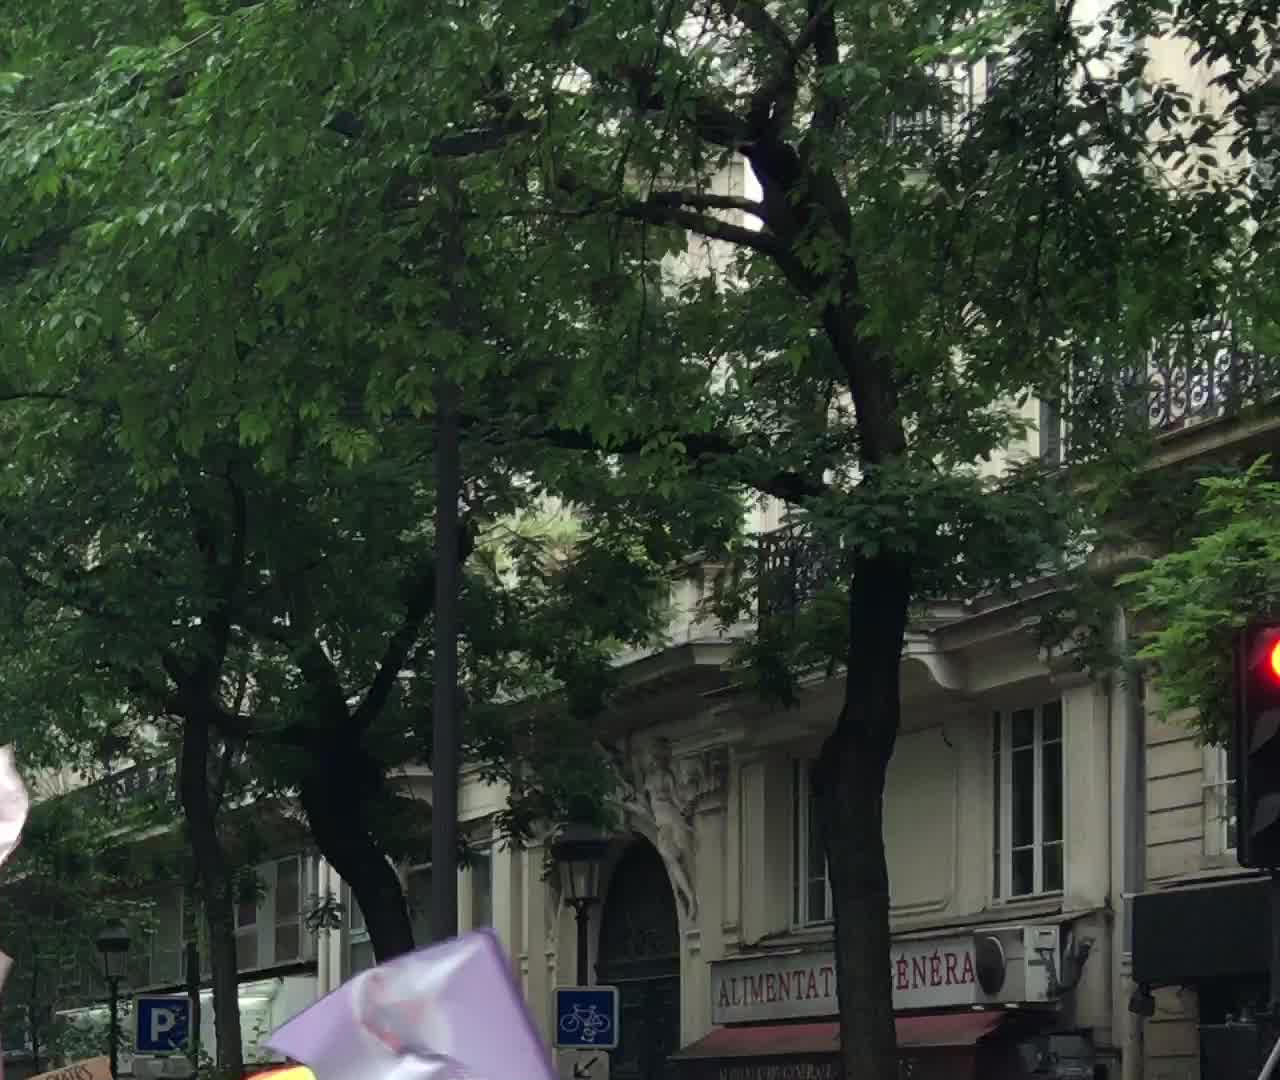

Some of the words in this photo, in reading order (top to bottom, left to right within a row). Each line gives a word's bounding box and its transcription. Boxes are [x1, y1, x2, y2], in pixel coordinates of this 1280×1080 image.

[719, 964, 834, 1008] ALIMENTAT
[894, 947, 976, 991] ÉNÉRA
[151, 1007, 176, 1042] P
